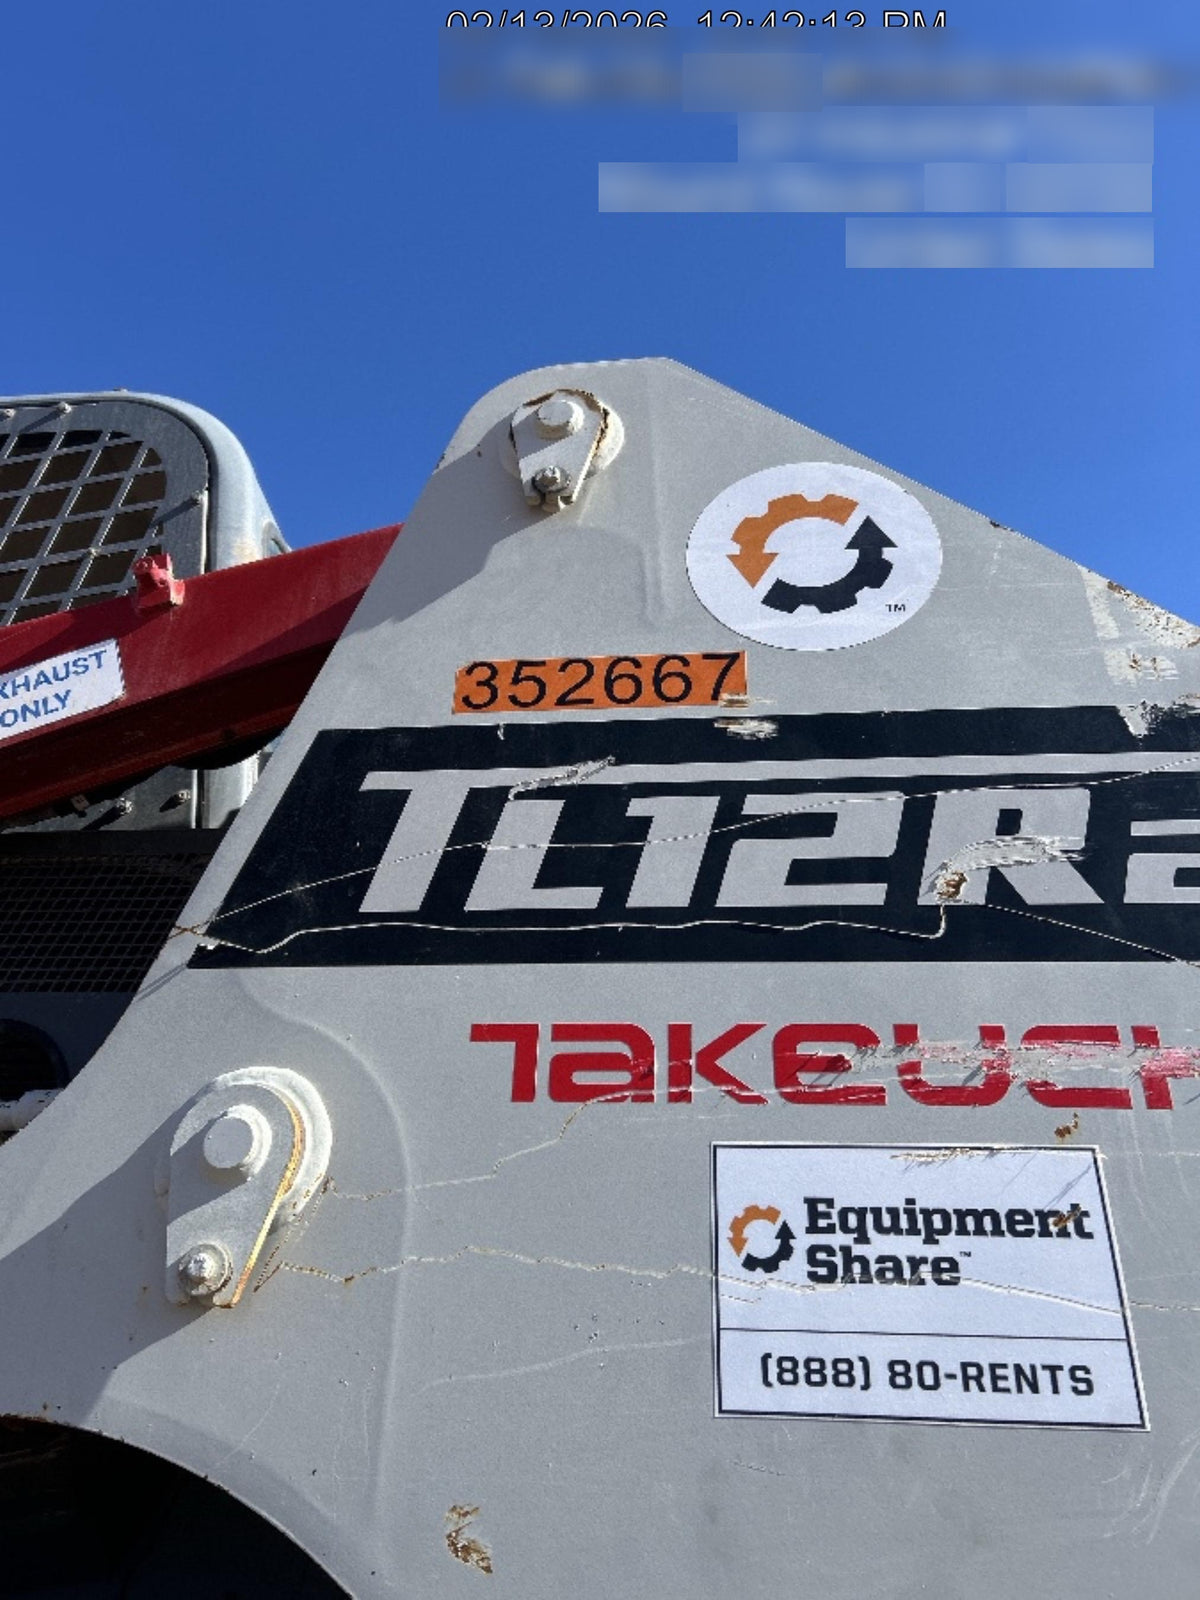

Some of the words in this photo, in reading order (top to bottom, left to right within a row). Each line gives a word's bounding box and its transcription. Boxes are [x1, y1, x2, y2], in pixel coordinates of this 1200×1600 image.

[462, 652, 740, 710] 352667
[0, 690, 71, 727] ONLY
[803, 1197, 1094, 1245] Equipment
[760, 1353, 870, 1391] (888)
[888, 1360, 1094, 1396] 80-RENTS
